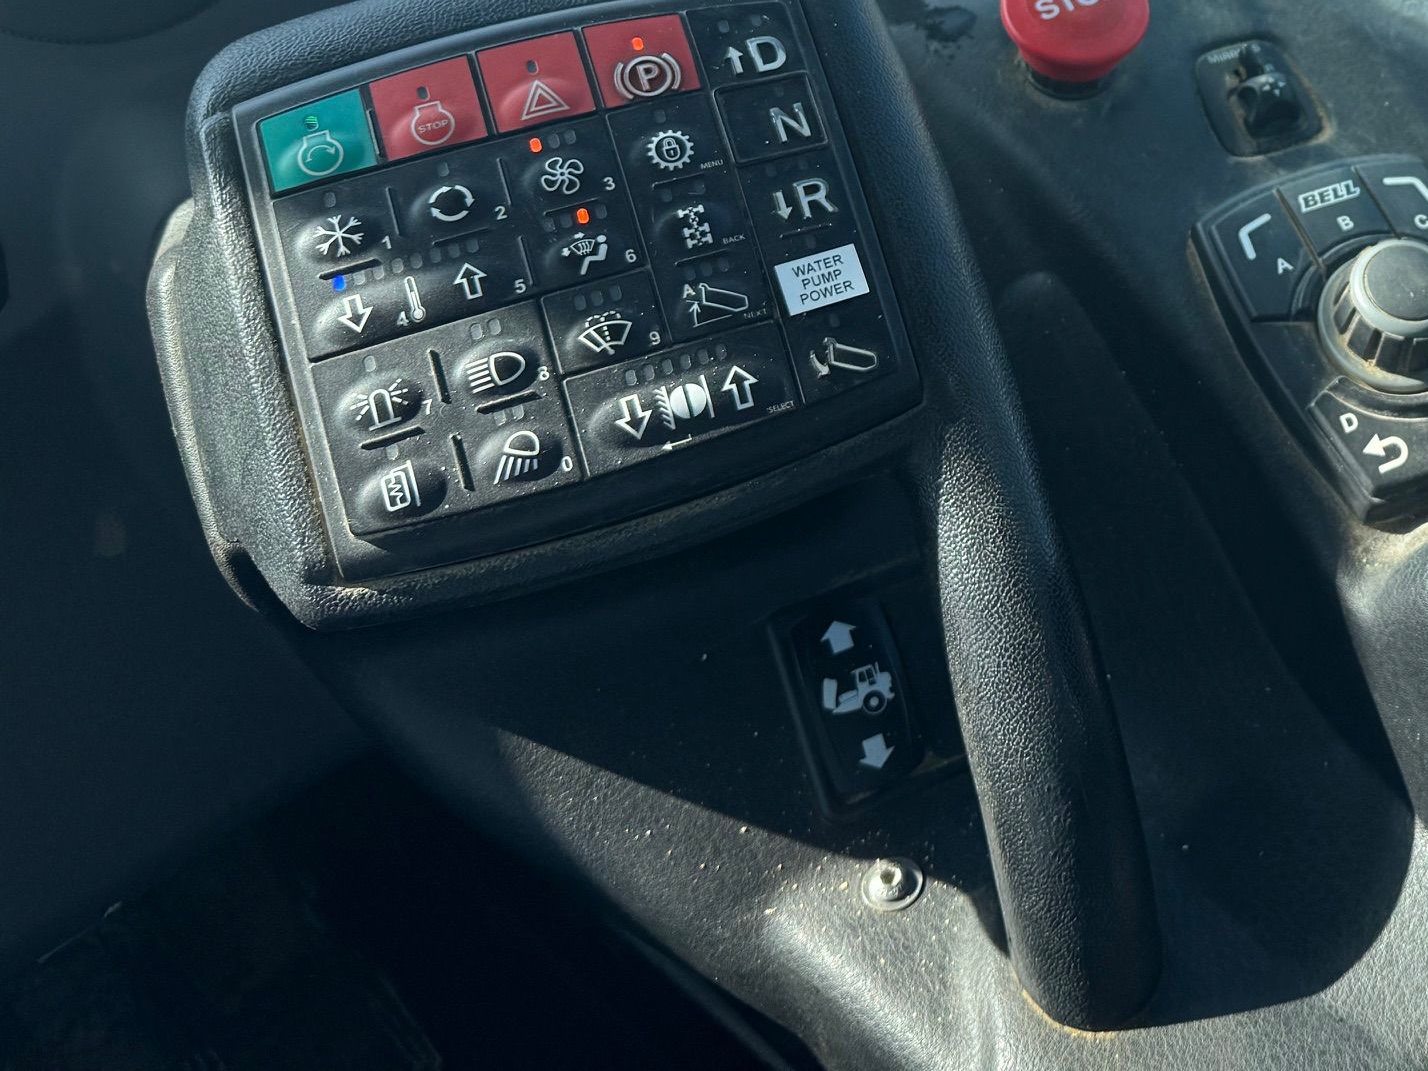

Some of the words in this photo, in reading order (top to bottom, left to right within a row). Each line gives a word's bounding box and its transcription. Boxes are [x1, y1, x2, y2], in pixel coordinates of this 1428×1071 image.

[746, 35, 787, 73] D
[1208, 43, 1261, 64] MIRRS
[418, 118, 450, 134] STOP
[769, 102, 812, 143] N
[700, 159, 724, 170] MENU
[604, 176, 616, 191] 3
[793, 178, 839, 219] R
[1299, 181, 1360, 212] BELL
[494, 205, 508, 221] 2
[1337, 215, 1355, 231] B
[381, 235, 393, 251] 1
[722, 233, 746, 245] BACK
[625, 249, 637, 264] 6
[792, 254, 844, 278] WATER
[1277, 257, 1294, 274] A
[513, 279, 527, 294] 5
[801, 269, 842, 290] PUMP
[799, 280, 855, 305] POWER
[397, 311, 409, 326] 4
[649, 331, 661, 346] 9
[537, 366, 550, 381] 8
[422, 399, 434, 416] 7
[768, 400, 795, 414] SELECT
[1339, 412, 1359, 433] D
